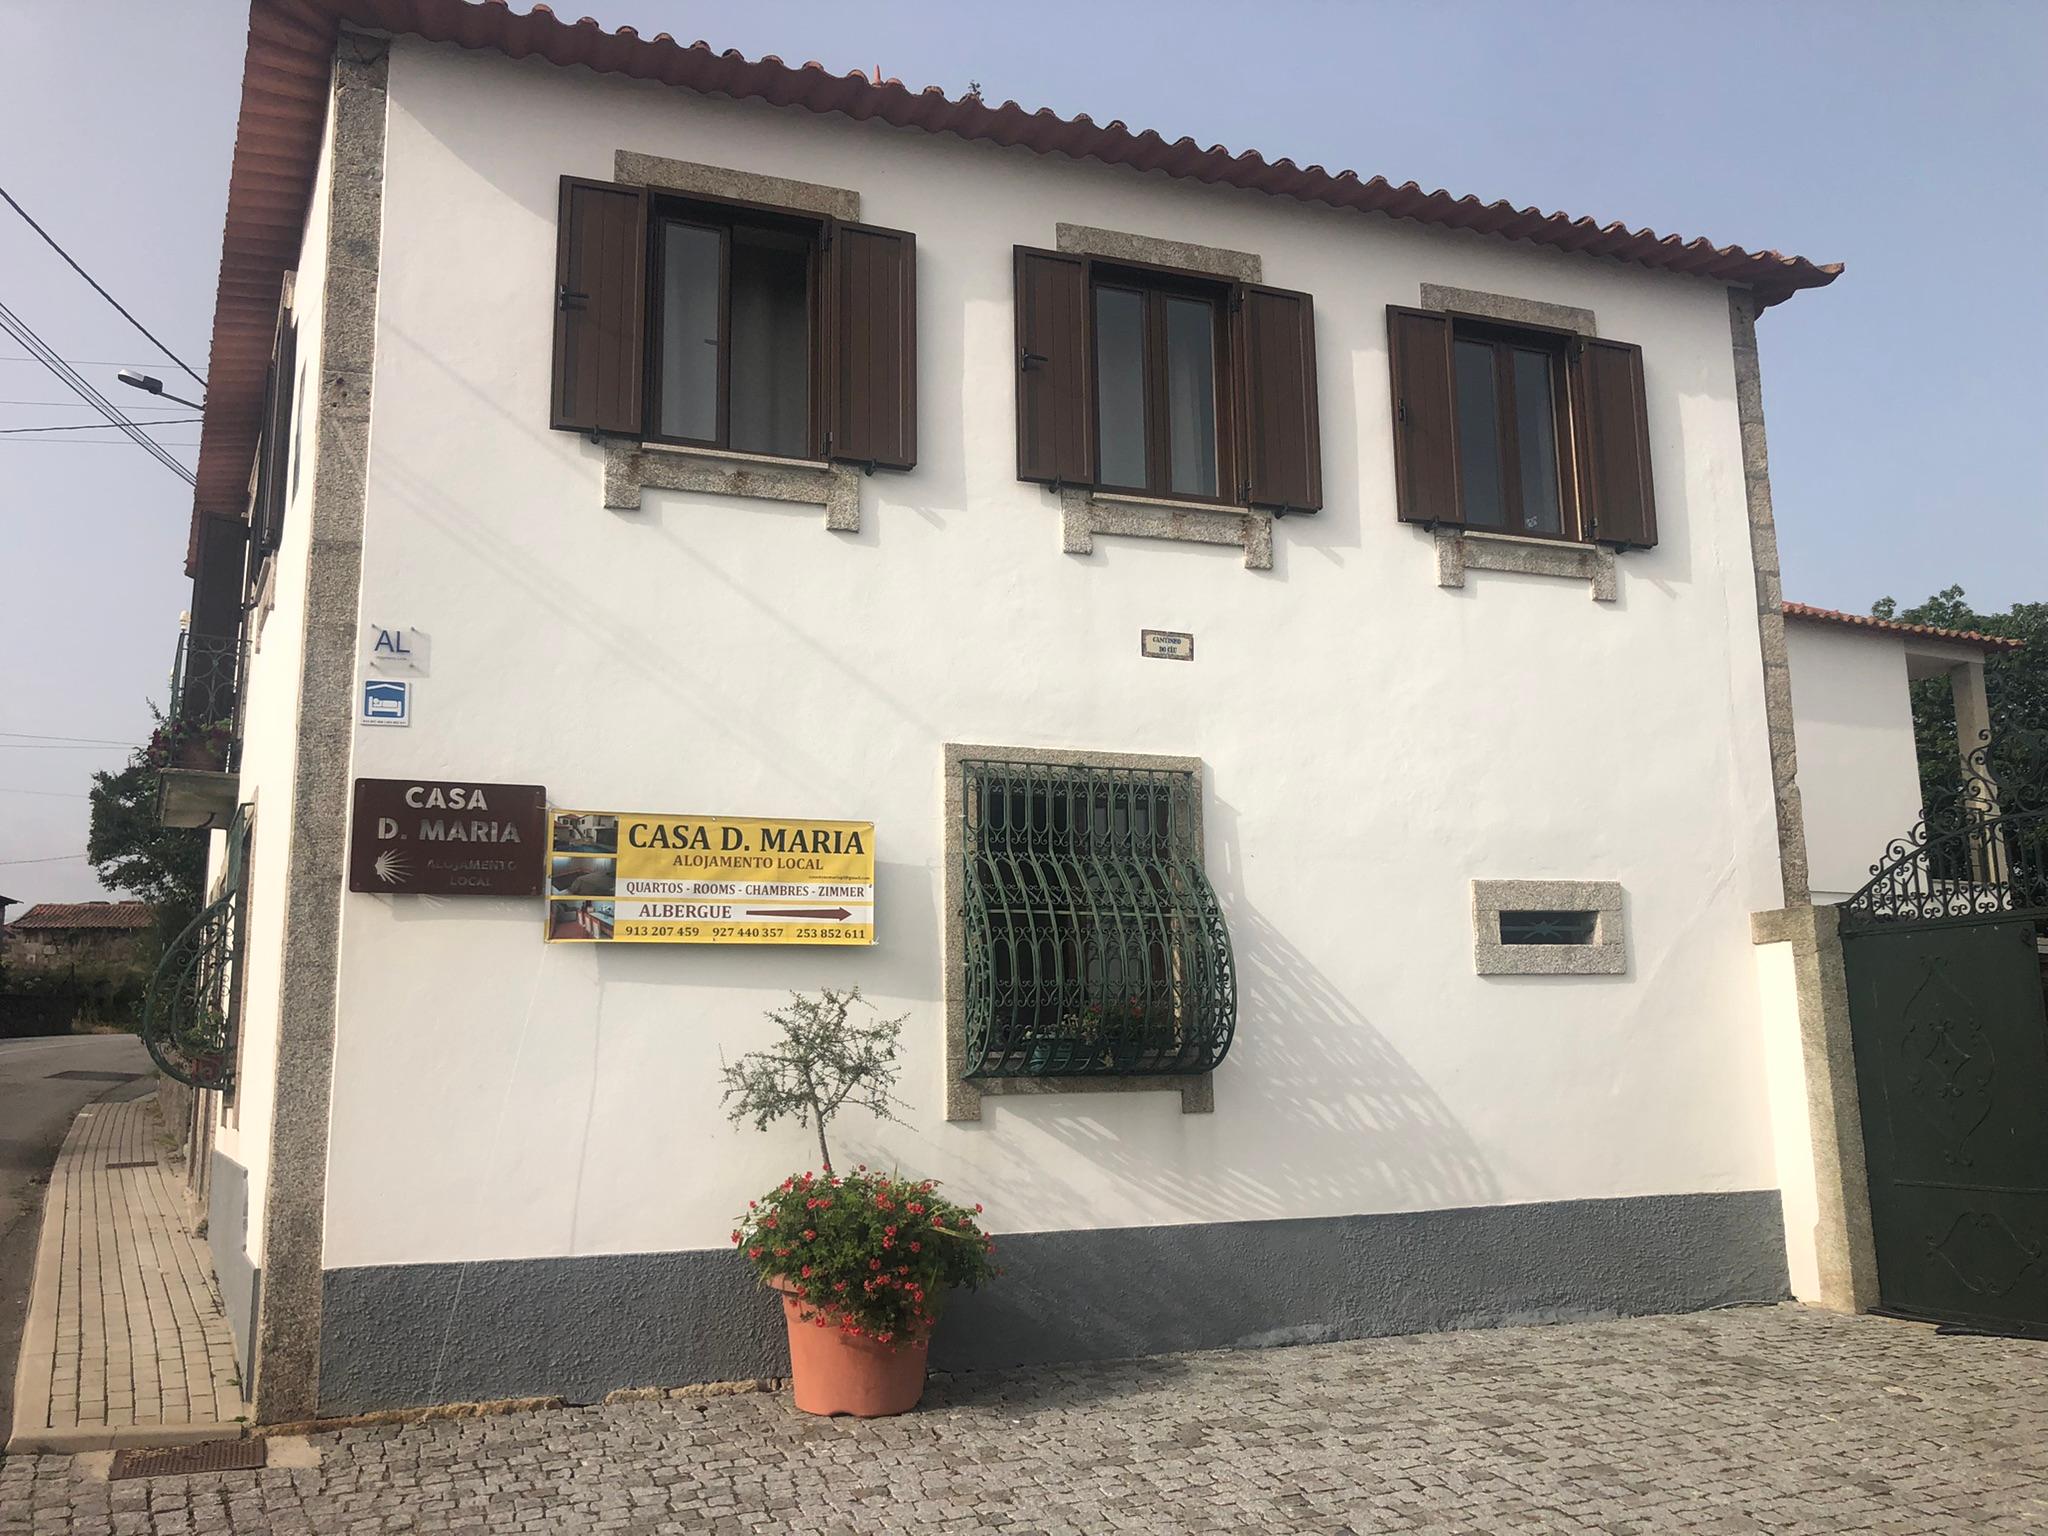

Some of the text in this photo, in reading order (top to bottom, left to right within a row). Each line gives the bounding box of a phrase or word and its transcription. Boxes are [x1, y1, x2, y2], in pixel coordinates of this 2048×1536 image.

[374, 630, 410, 653] AL
[405, 786, 488, 811] CASA
[378, 817, 521, 843] D. MARIA
[628, 823, 865, 855] CASA D. MARIA
[427, 859, 517, 871] ALOJAMENTO
[672, 855, 824, 870] ALOJAMENTO LOCAL
[449, 875, 493, 887] LOCAL
[626, 882, 684, 895] QUARTOS
[693, 883, 736, 895] ROOMS
[745, 885, 809, 897] CHAMBRES
[818, 886, 865, 898] ZIMMER
[639, 904, 732, 919] ALBERGUE
[625, 926, 865, 939] 913 207 459 927 440 357 253 852 611
